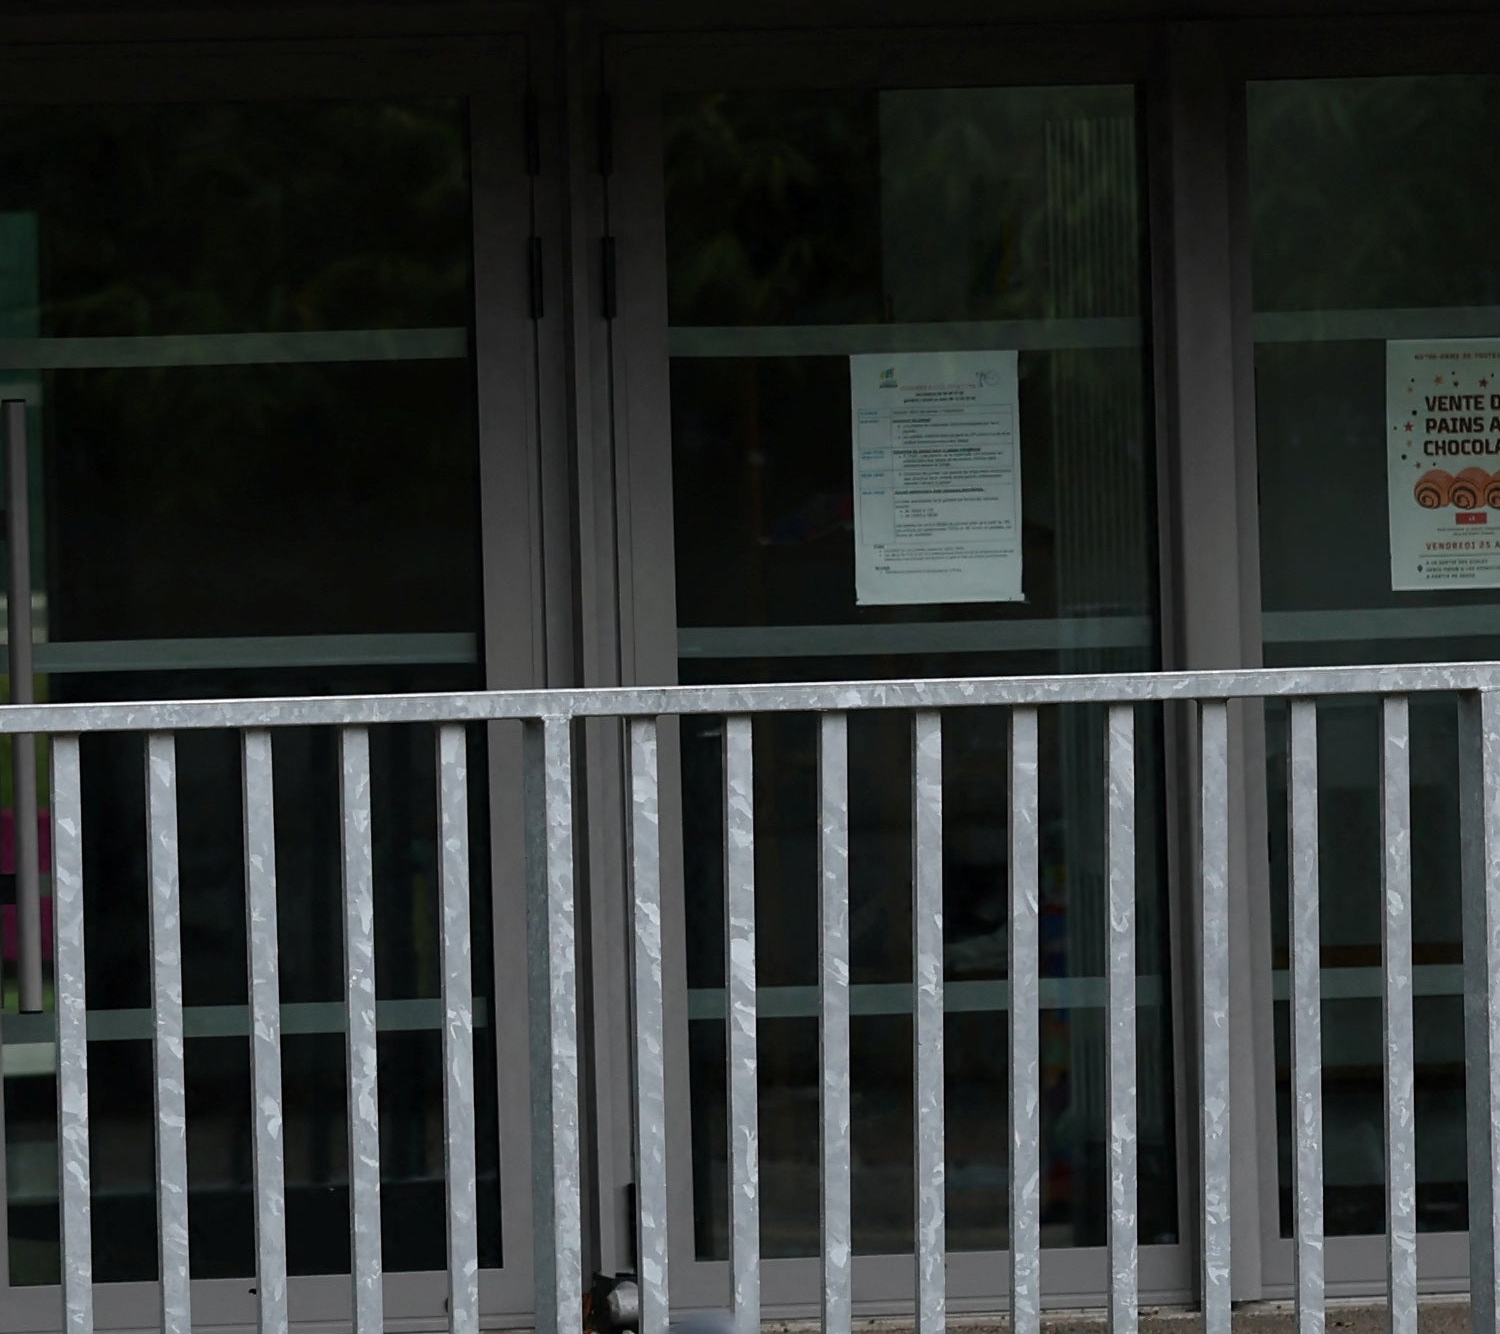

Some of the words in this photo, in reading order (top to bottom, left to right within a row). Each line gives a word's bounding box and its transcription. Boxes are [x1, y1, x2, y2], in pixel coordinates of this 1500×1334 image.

[1425, 394, 1485, 412] VENTE
[1425, 417, 1485, 434] PAINS
[1425, 541, 1476, 551] VENDREDI
